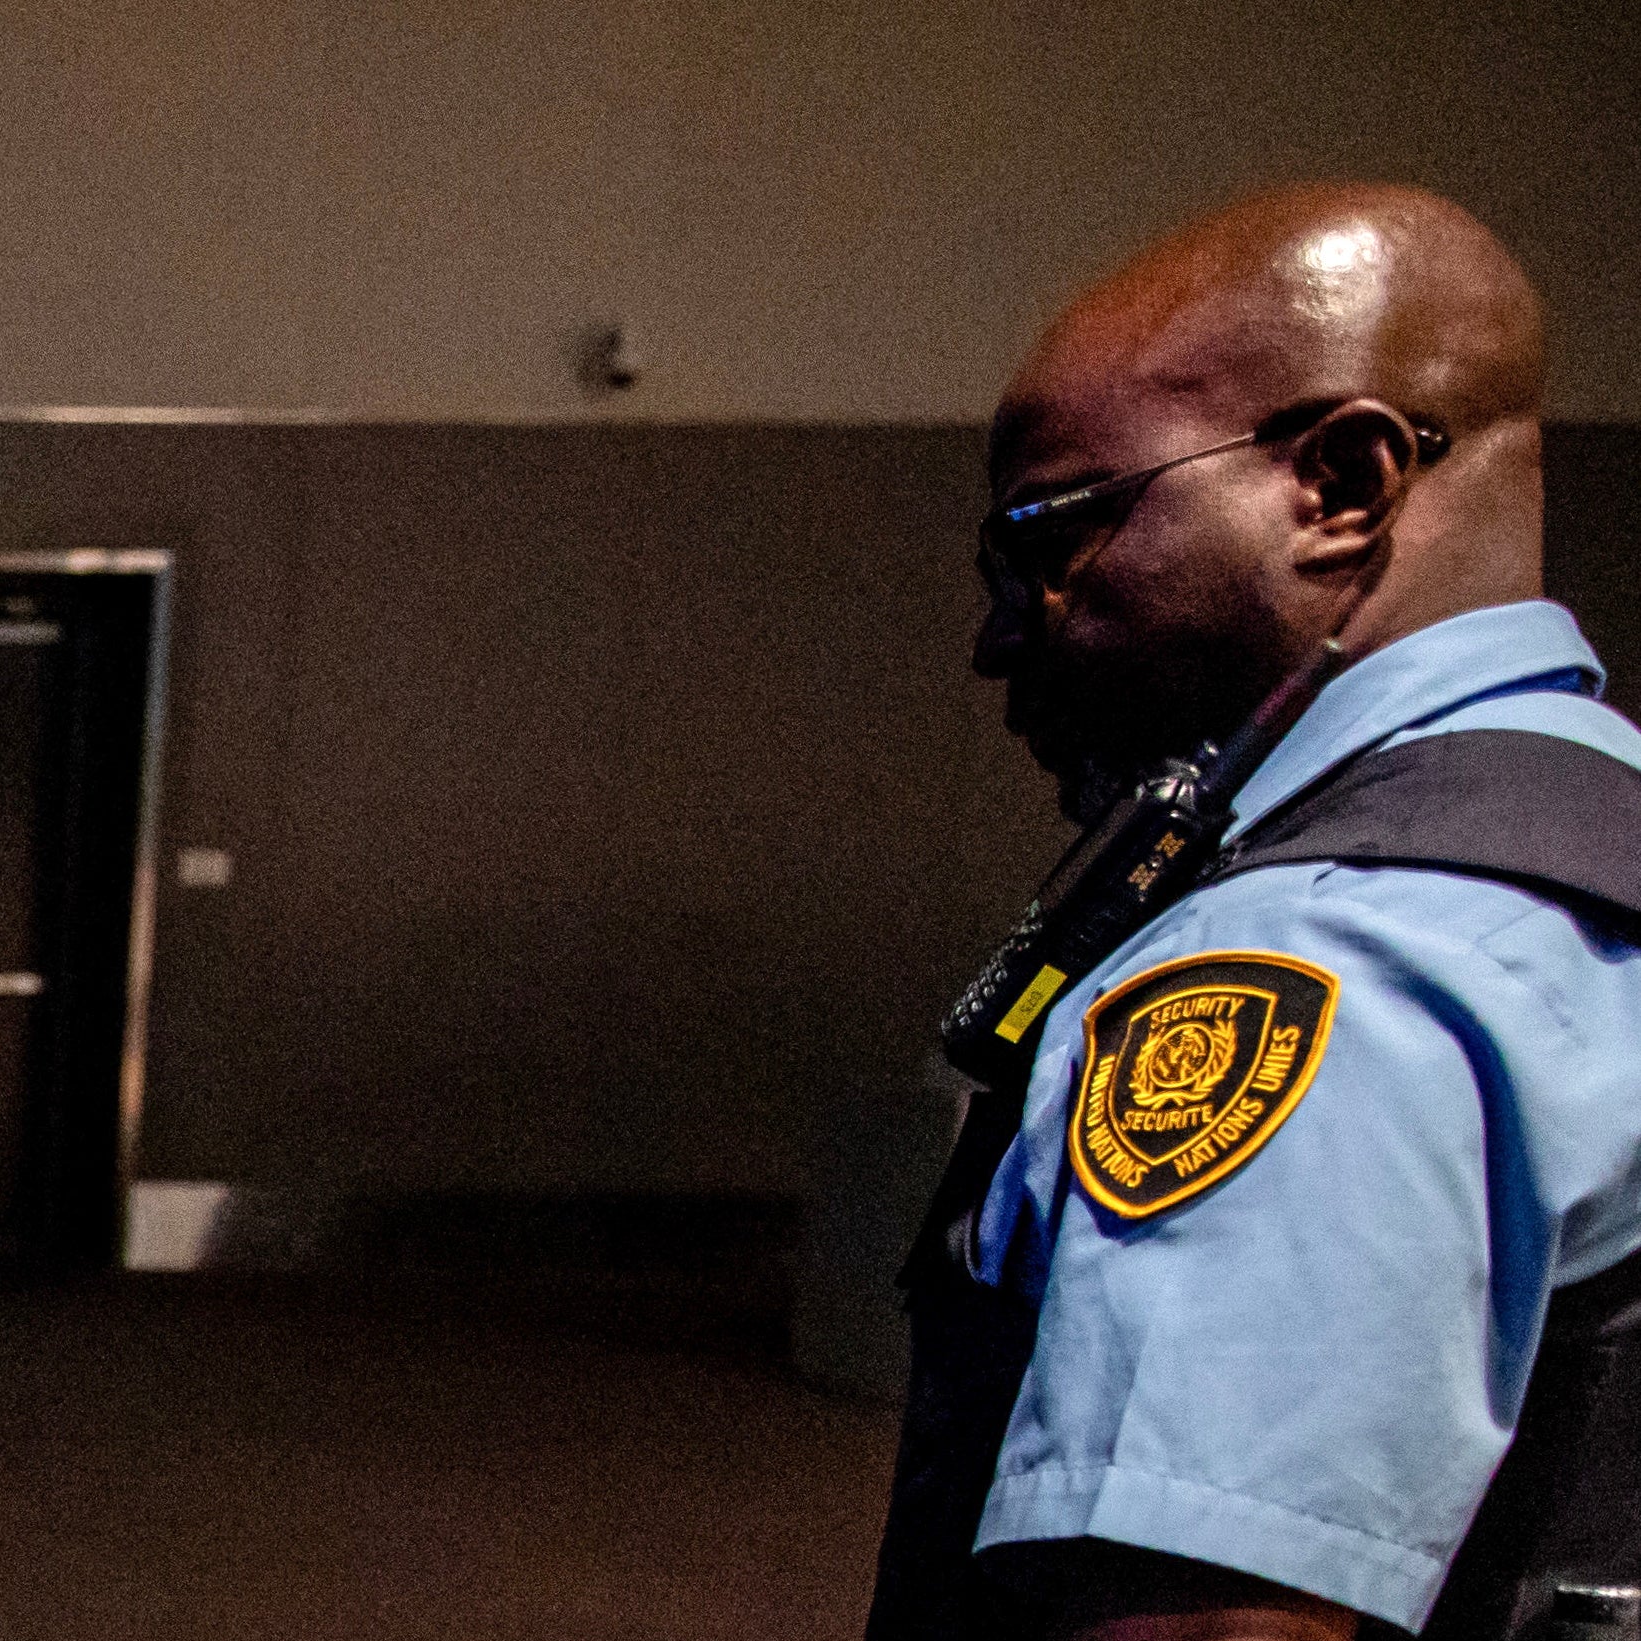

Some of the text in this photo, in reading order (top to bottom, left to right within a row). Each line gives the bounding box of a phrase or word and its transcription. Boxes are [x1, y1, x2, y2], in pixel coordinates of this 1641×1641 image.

[1150, 996, 1246, 1030] SECURITY
[1086, 1054, 1150, 1188] UNITED NATIONS
[1120, 1103, 1214, 1131] SECURITE
[1173, 1024, 1302, 1178] NATIONS UNIES
